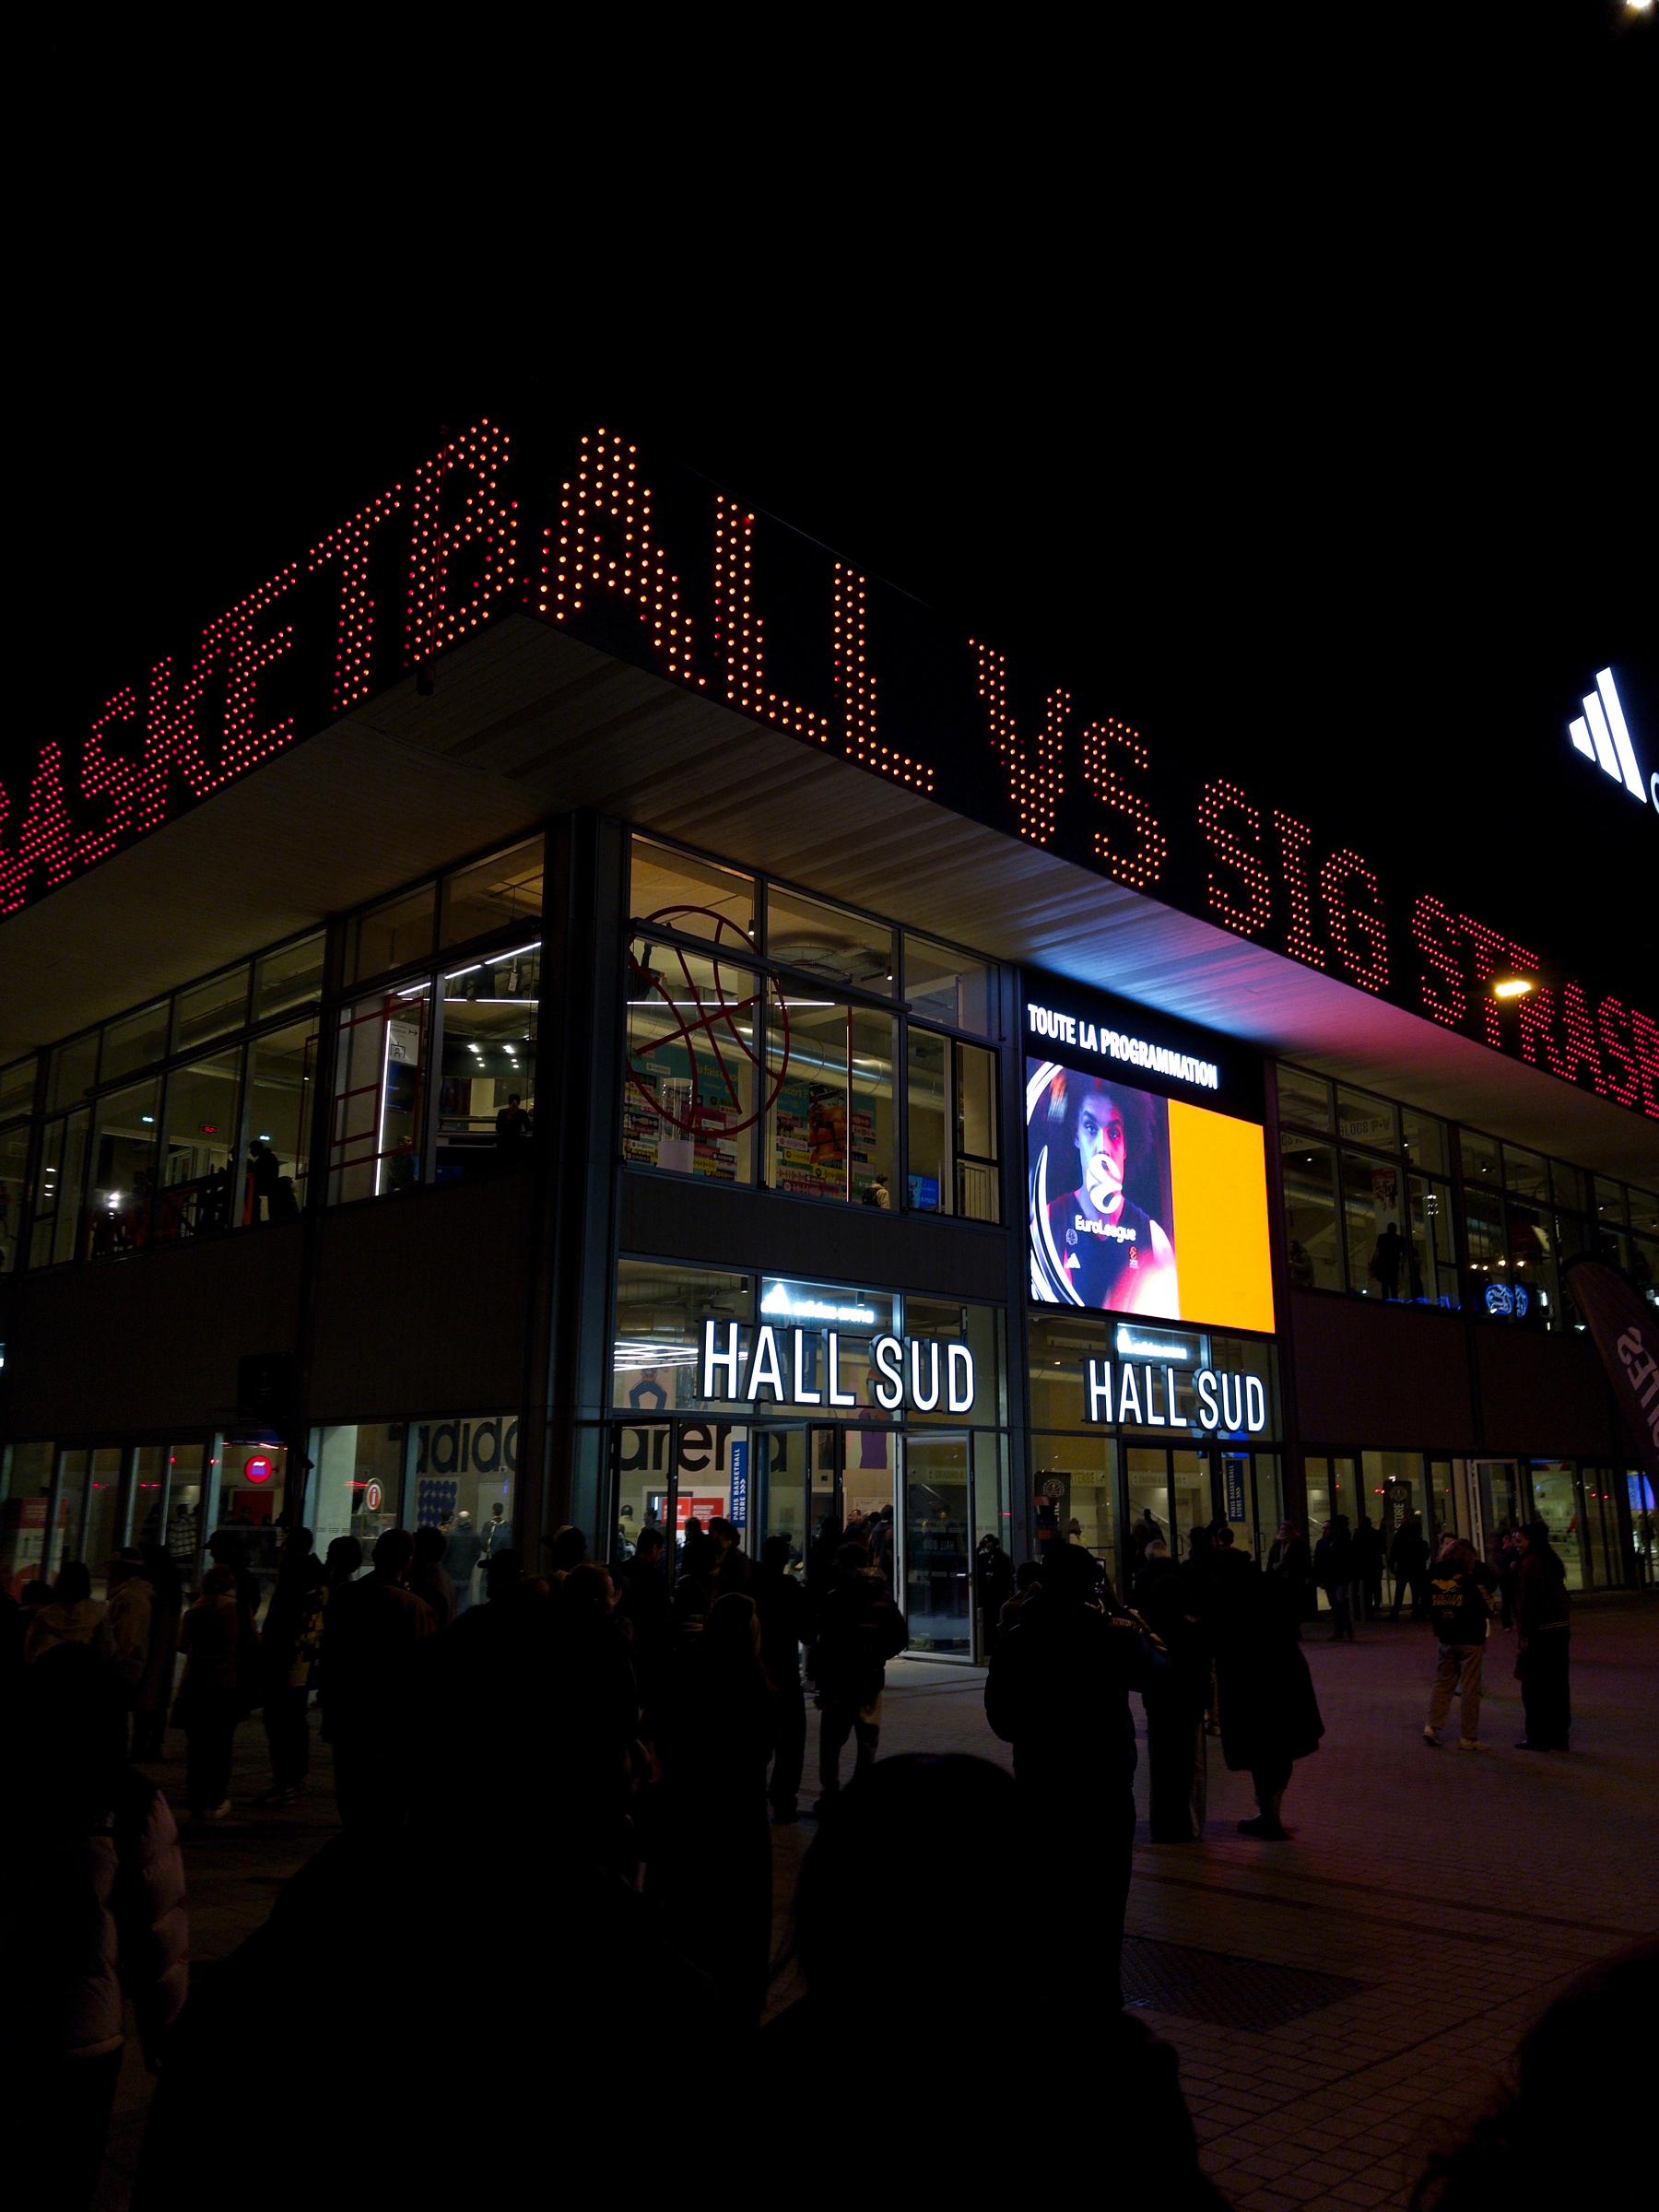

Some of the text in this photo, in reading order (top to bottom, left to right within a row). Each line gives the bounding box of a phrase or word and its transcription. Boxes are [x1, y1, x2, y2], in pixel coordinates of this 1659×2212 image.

[969, 639, 1167, 886] VS
[1198, 779, 1390, 992] SIG
[1028, 1004, 1218, 1089] TOUTE LA PROGRAMMATION
[1075, 1214, 1136, 1243] EuroLeague
[703, 1319, 975, 1413] HALL SUD
[1089, 1359, 1265, 1431] HALL SUD
[733, 1448, 741, 1496] BASKETBALL
[1394, 1502, 1405, 1530] STORE
